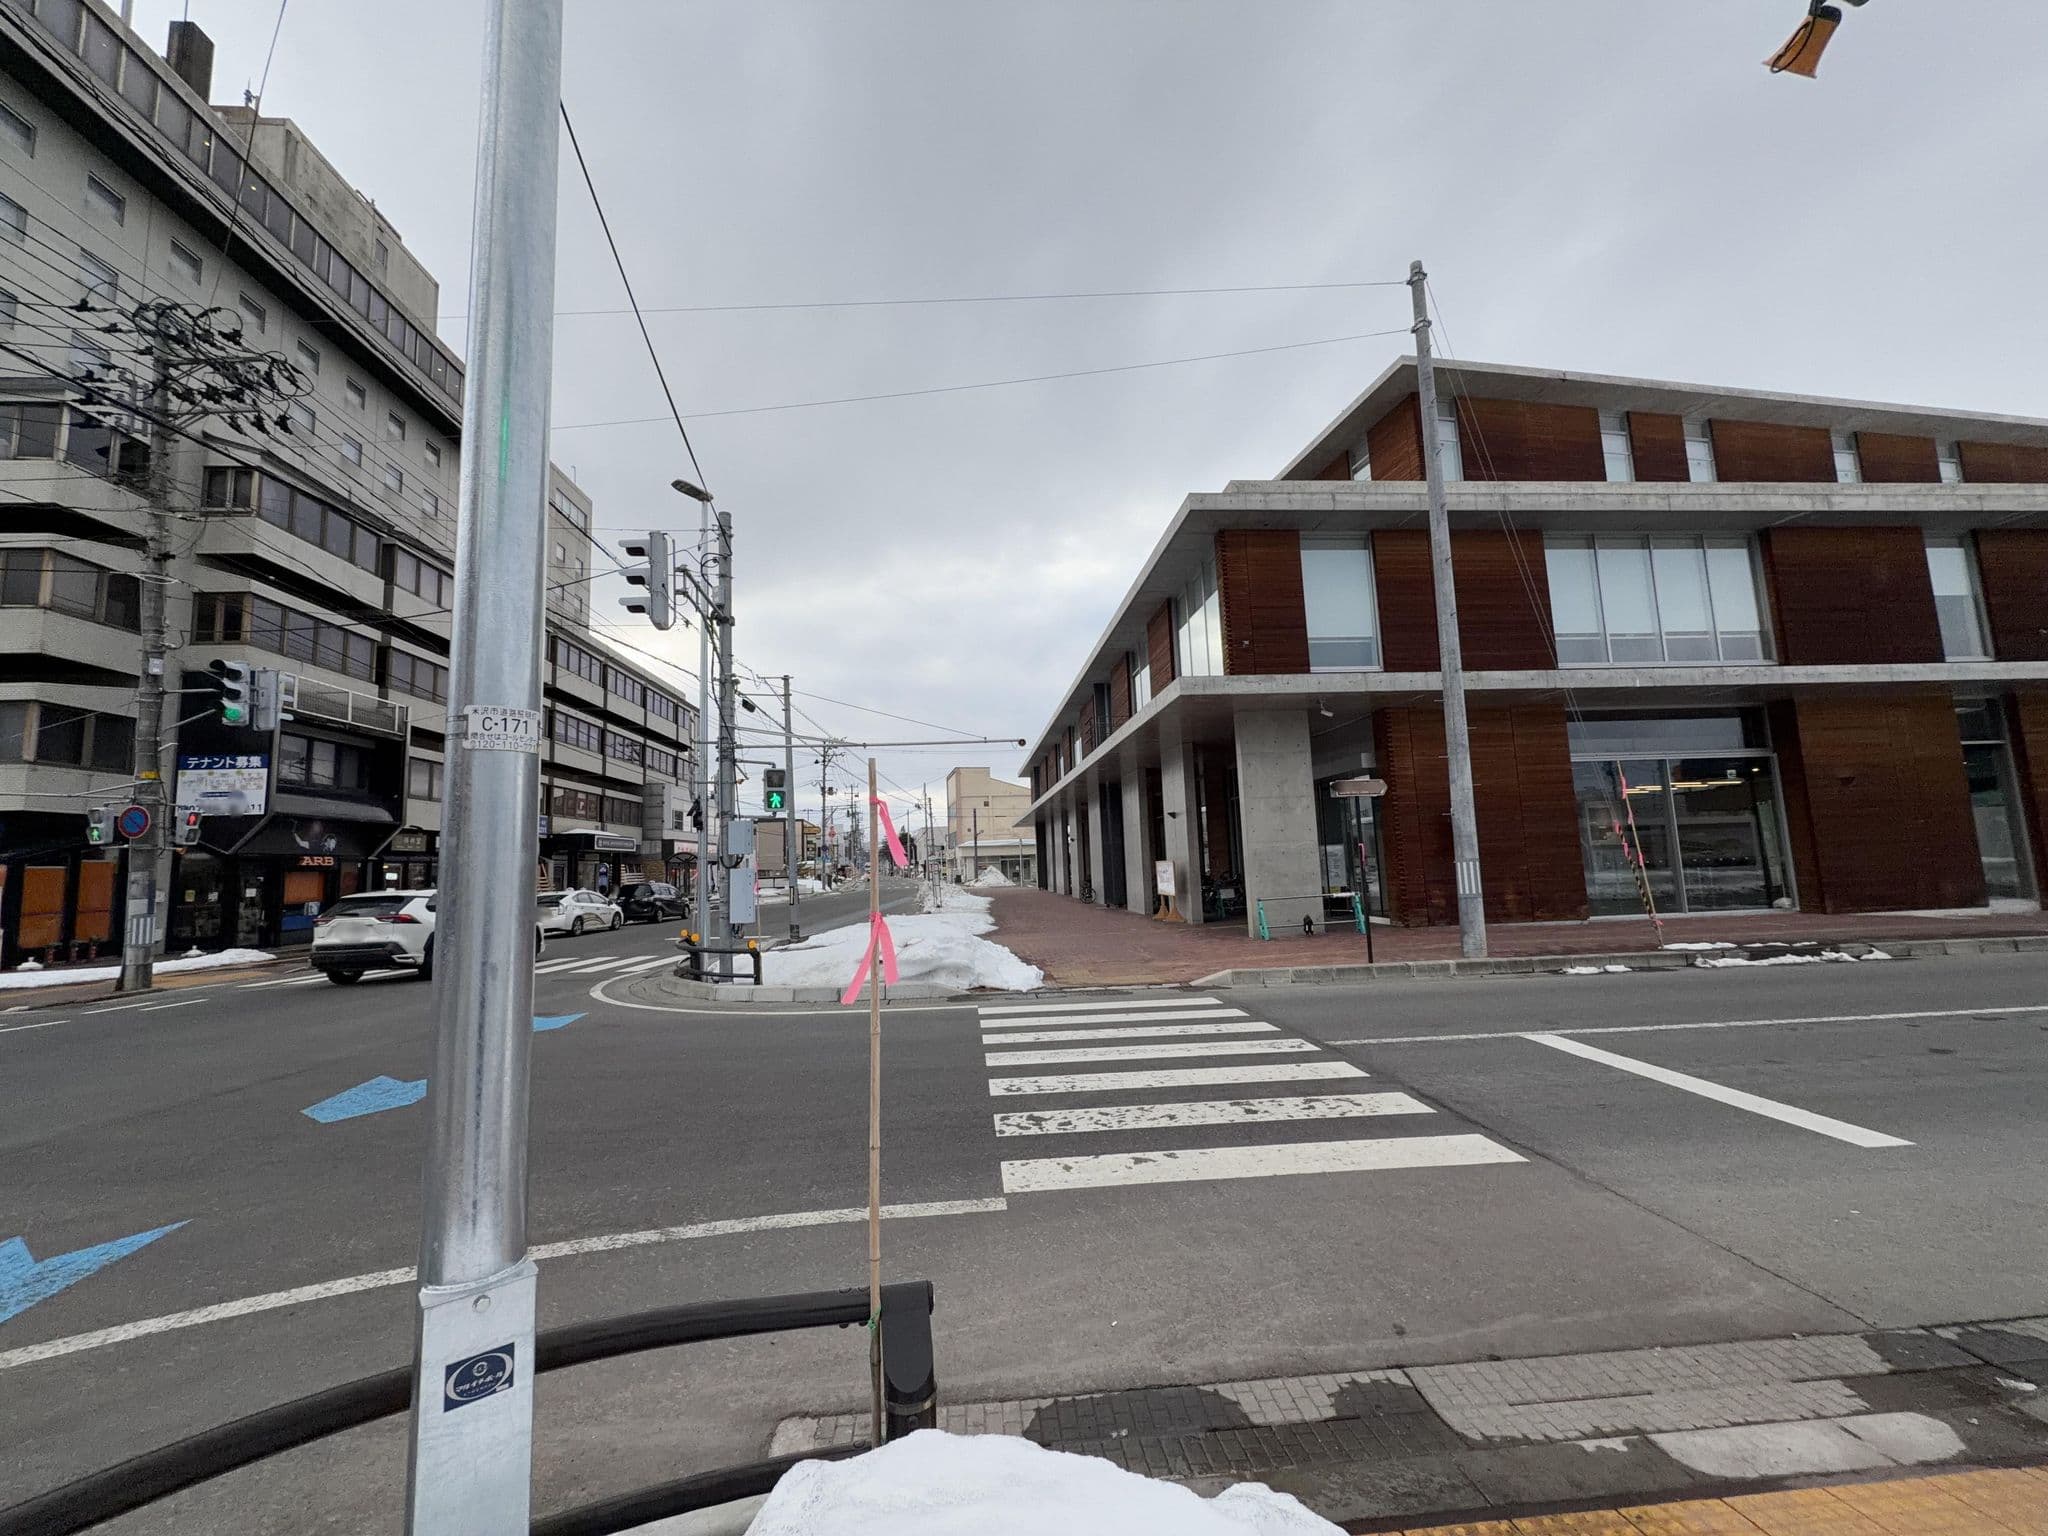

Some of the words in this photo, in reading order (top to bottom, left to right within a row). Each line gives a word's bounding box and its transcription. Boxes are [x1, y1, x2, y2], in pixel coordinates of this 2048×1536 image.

[187, 755, 262, 769] テナント募集
